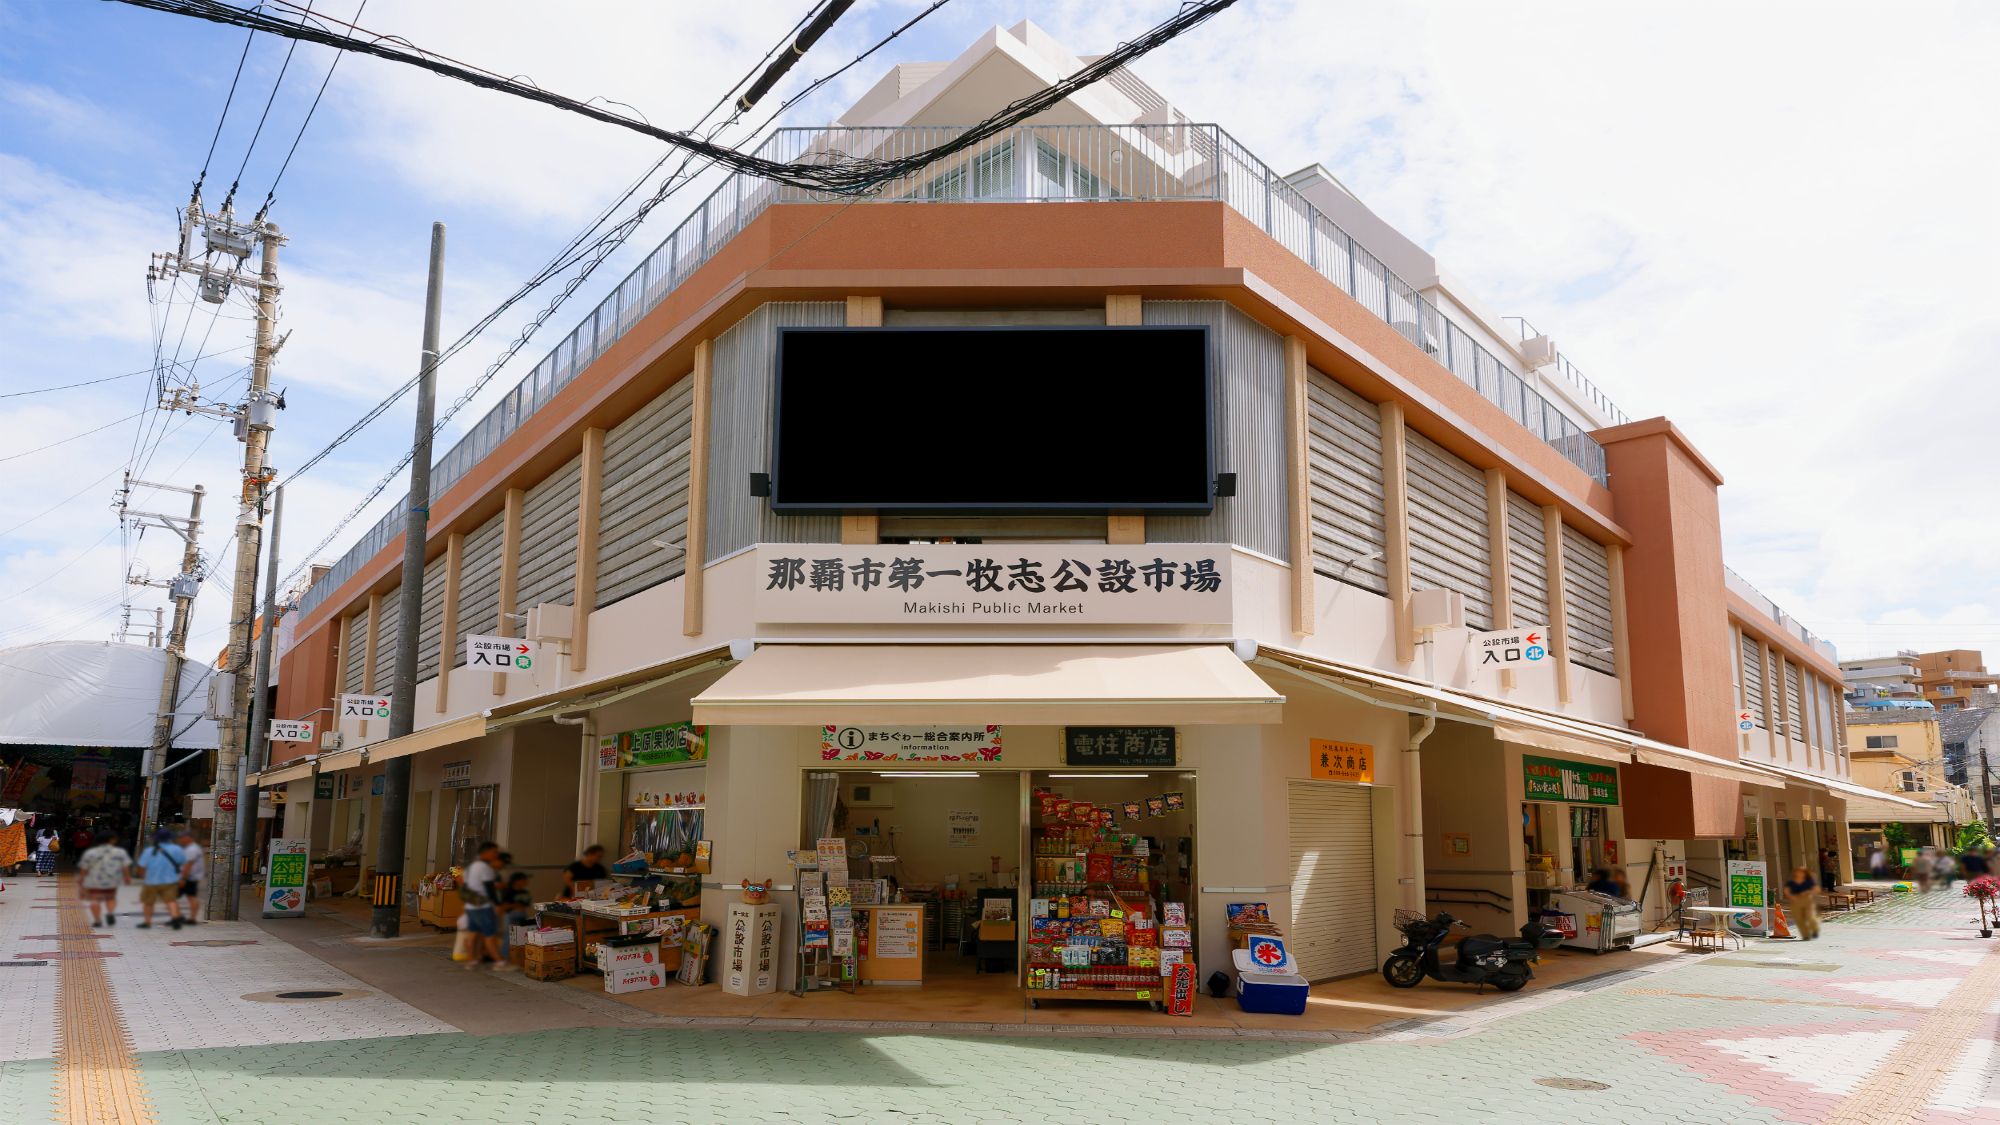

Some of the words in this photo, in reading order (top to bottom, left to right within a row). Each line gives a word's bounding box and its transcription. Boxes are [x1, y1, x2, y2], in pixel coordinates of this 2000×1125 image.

[767, 557, 1221, 594] 那覇市第一牧志公設市場
[904, 602, 965, 614] Makishi
[973, 602, 1020, 614] Public
[1028, 602, 1084, 614] Market
[474, 642, 511, 652] 公設市場
[1483, 636, 1520, 647] 公設市場
[473, 652, 511, 666] 入口
[1482, 648, 1521, 664] 入口
[1527, 647, 1542, 660] 北
[345, 706, 374, 716] 入口
[274, 729, 297, 738] 入口
[632, 726, 688, 752] 上原果物店
[1074, 733, 1170, 756] 電柱商店
[1320, 752, 1367, 771] 兼次商店
[273, 862, 305, 873] 公設
[272, 873, 304, 886] 市場
[1733, 882, 1763, 894] 公設
[1733, 894, 1763, 906] 市場
[732, 919, 746, 972] 公設市場
[758, 919, 773, 972] 公設市場
[1257, 943, 1282, 964] 氷
[1174, 966, 1191, 1013] 大売出し
